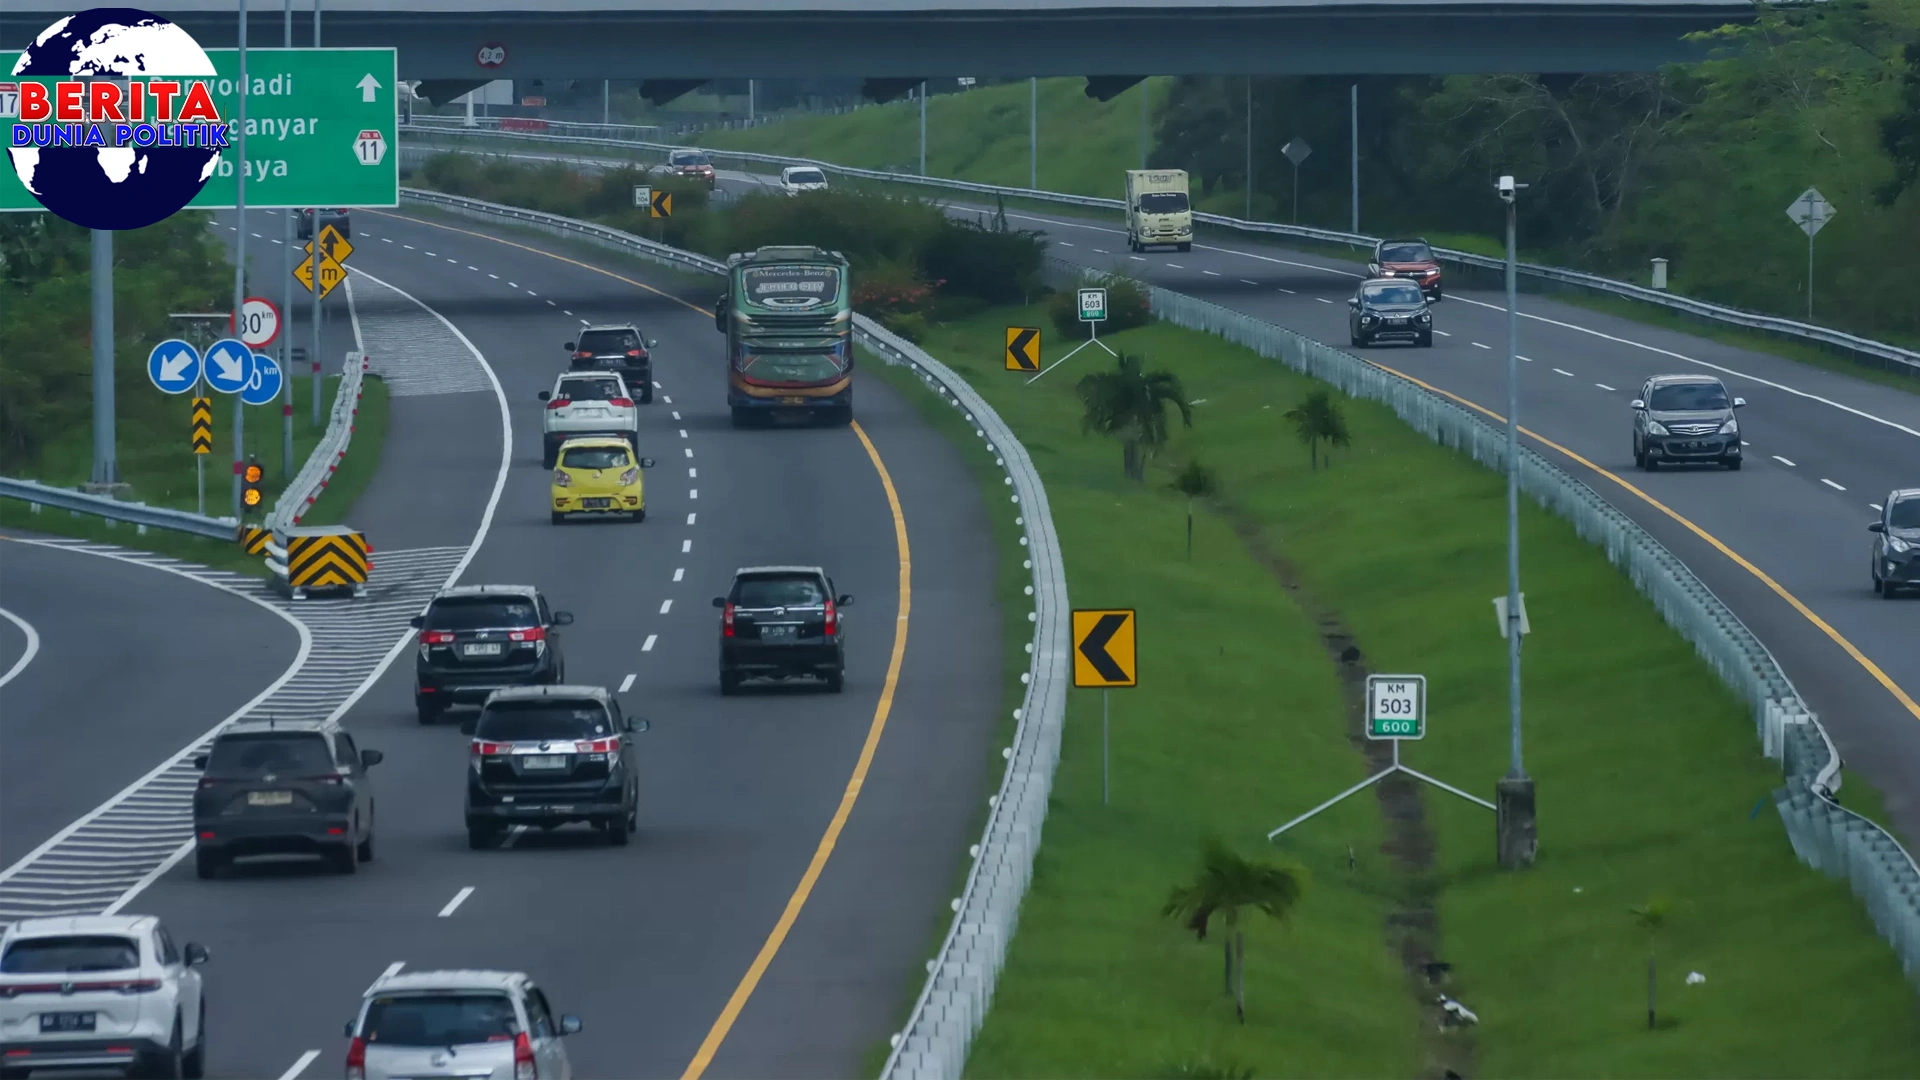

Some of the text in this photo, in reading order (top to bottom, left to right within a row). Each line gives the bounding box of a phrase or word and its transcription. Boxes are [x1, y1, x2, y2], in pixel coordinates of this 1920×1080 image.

[359, 141, 377, 160] 11
[322, 268, 337, 280] m
[1084, 300, 1101, 309] 503
[262, 311, 274, 319] km
[263, 366, 278, 375] km
[1387, 684, 1405, 693] KM
[1380, 698, 1411, 714] 503
[1382, 721, 1410, 733] 600
